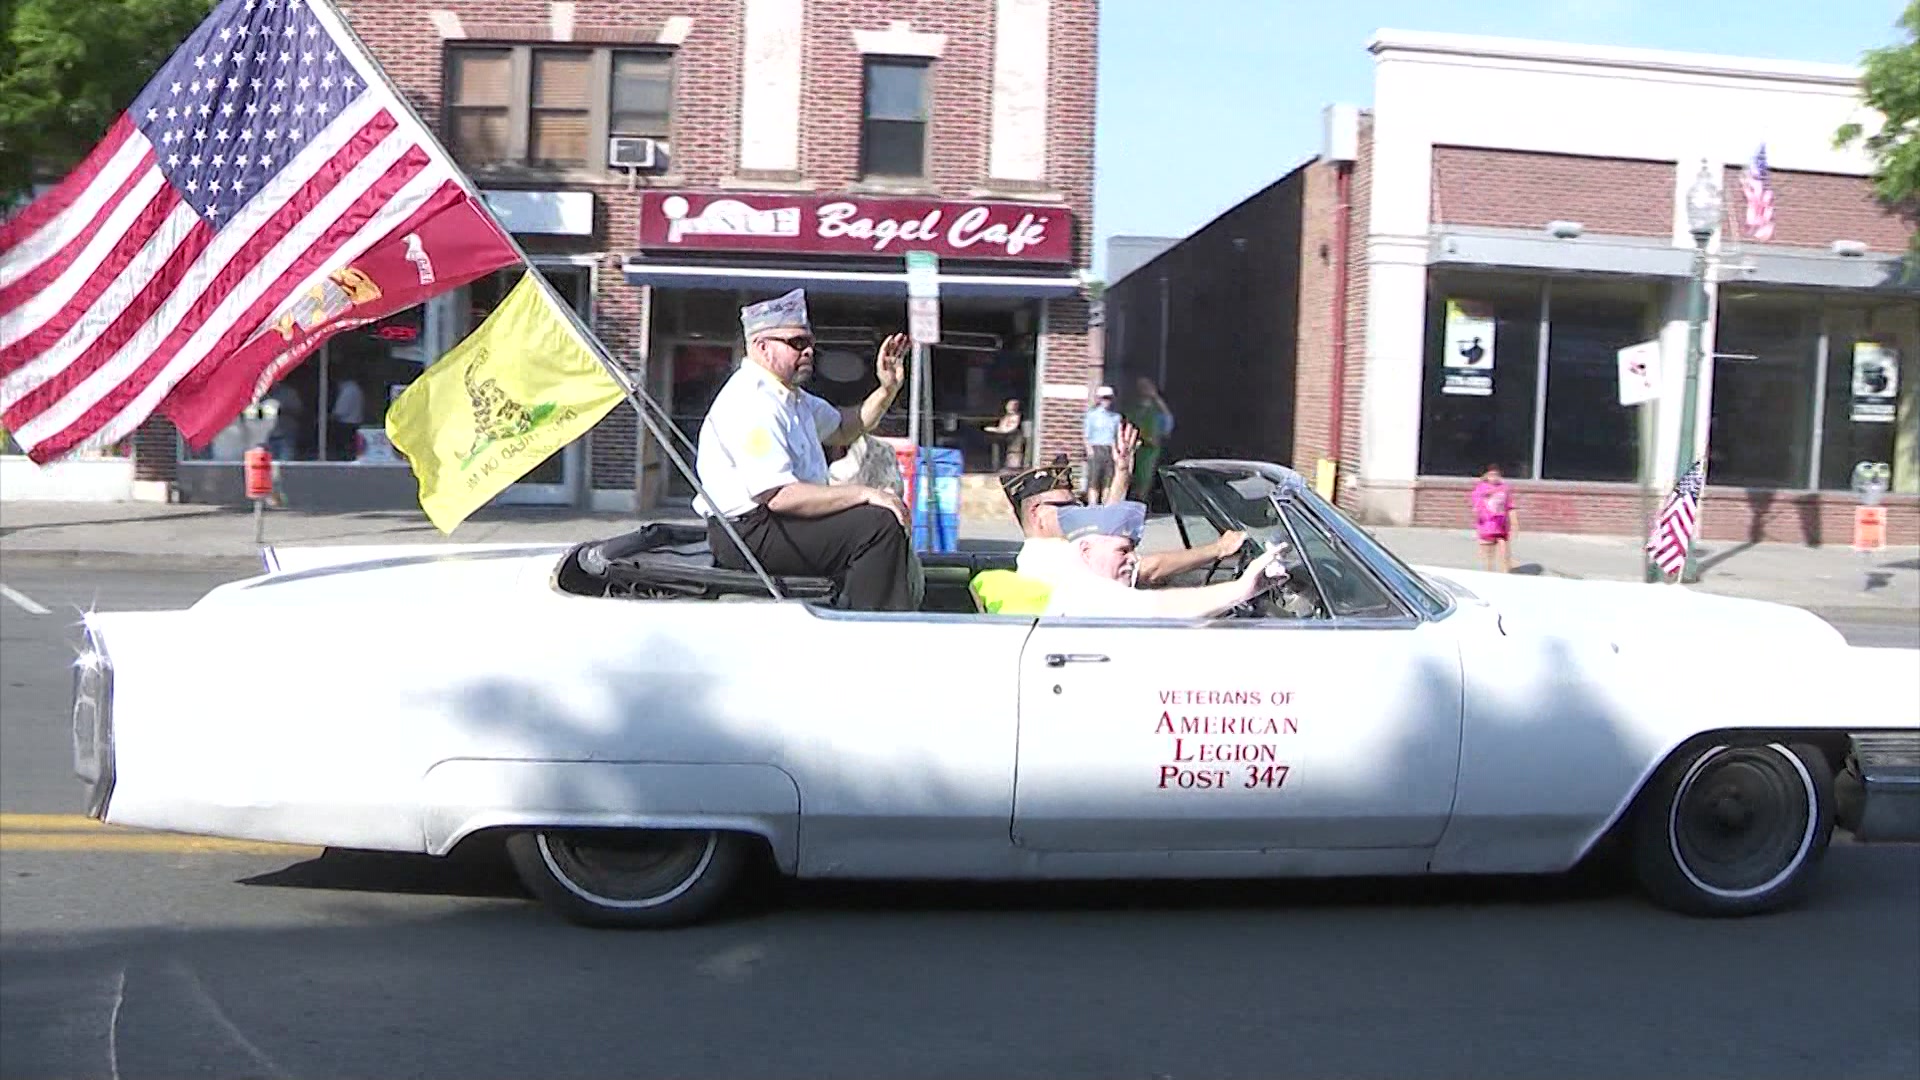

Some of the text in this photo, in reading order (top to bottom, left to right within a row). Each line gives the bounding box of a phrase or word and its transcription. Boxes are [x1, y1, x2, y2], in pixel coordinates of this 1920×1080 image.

[816, 202, 943, 251] Bagel
[947, 206, 1050, 255] Café
[1159, 690, 1296, 706] VETERANS OF
[1155, 710, 1299, 735] AMERICAN
[1173, 738, 1278, 763] LEGION
[1157, 764, 1290, 789] POST 347
